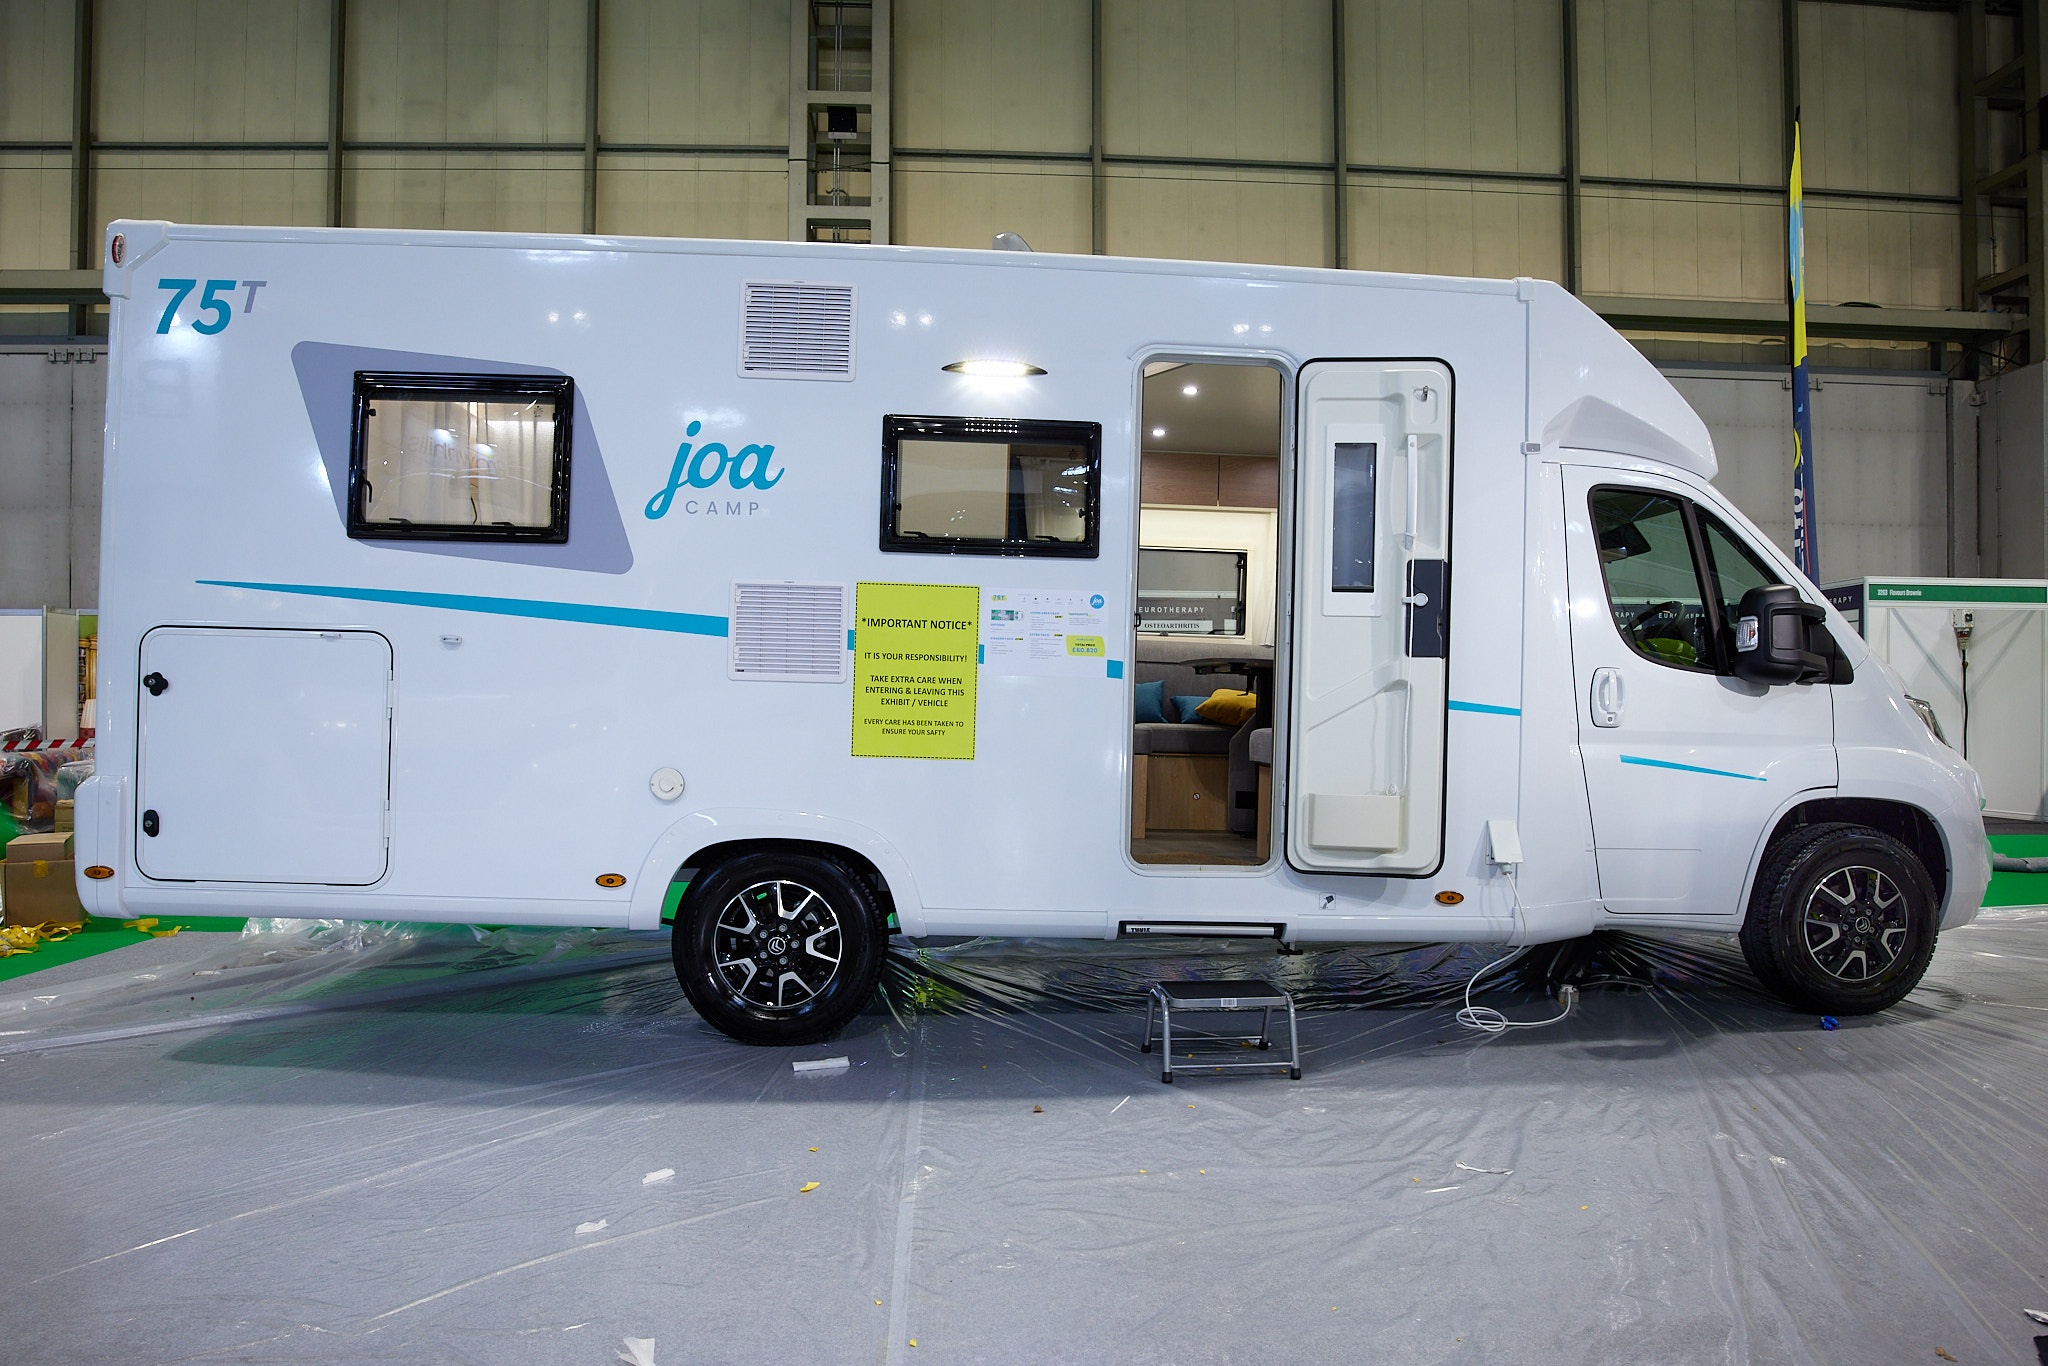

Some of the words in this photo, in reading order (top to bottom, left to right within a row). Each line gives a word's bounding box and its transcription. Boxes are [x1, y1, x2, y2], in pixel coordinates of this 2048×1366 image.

[644, 420, 785, 520] joa
[685, 500, 760, 516] CAMP
[1906, 589, 1922, 597] Brownie
[864, 652, 871, 660] IT
[882, 653, 903, 661] YOUR
[905, 653, 967, 663] RESPONSIBILITY!
[870, 675, 889, 683] TAKE
[891, 675, 915, 683] EXTRA
[916, 676, 937, 684] CARE
[938, 677, 962, 685] WHEN
[865, 686, 904, 695] ENTERING
[905, 687, 912, 695] &
[913, 687, 946, 696] LEAVING
[947, 688, 965, 697] THIS
[880, 698, 910, 706] EXHIBIT
[911, 698, 916, 707] /
[917, 699, 949, 707] VEHICLE
[864, 718, 883, 726] EVERY
[907, 728, 926, 736] YOUR
[926, 729, 946, 737] SAFTY
